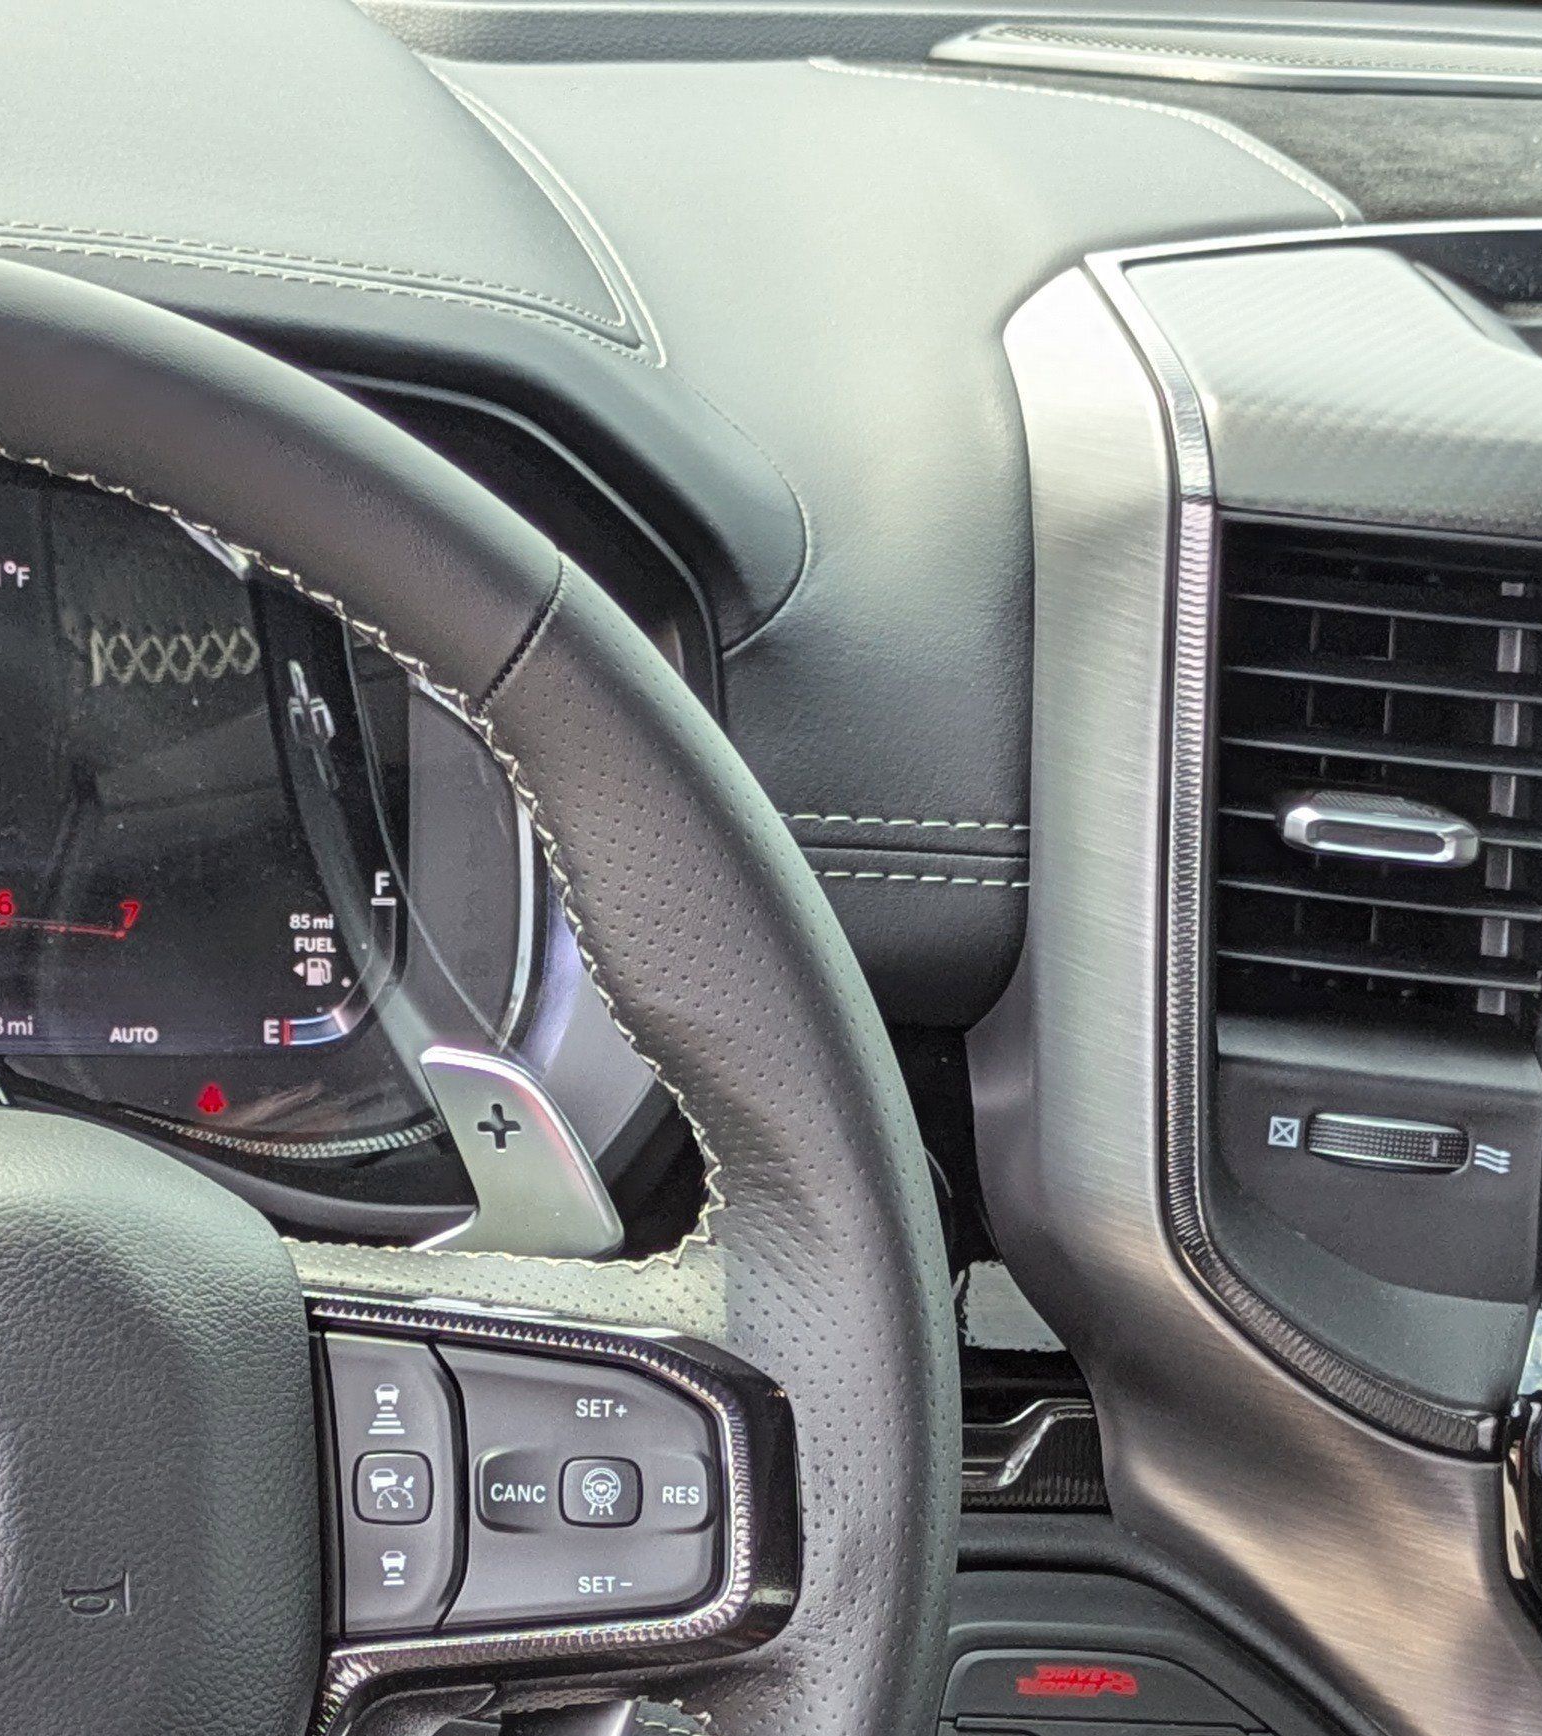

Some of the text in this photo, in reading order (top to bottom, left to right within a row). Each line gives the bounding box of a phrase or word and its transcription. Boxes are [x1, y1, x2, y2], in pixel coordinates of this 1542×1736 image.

[374, 870, 391, 896] F
[289, 913, 334, 930] 85 mi
[293, 936, 337, 954] FUEL
[7, 1013, 35, 1037] mi
[109, 1026, 159, 1044] AUTO
[263, 1018, 280, 1045] E
[490, 1483, 547, 1504] CANC
[661, 1486, 701, 1506] RES
